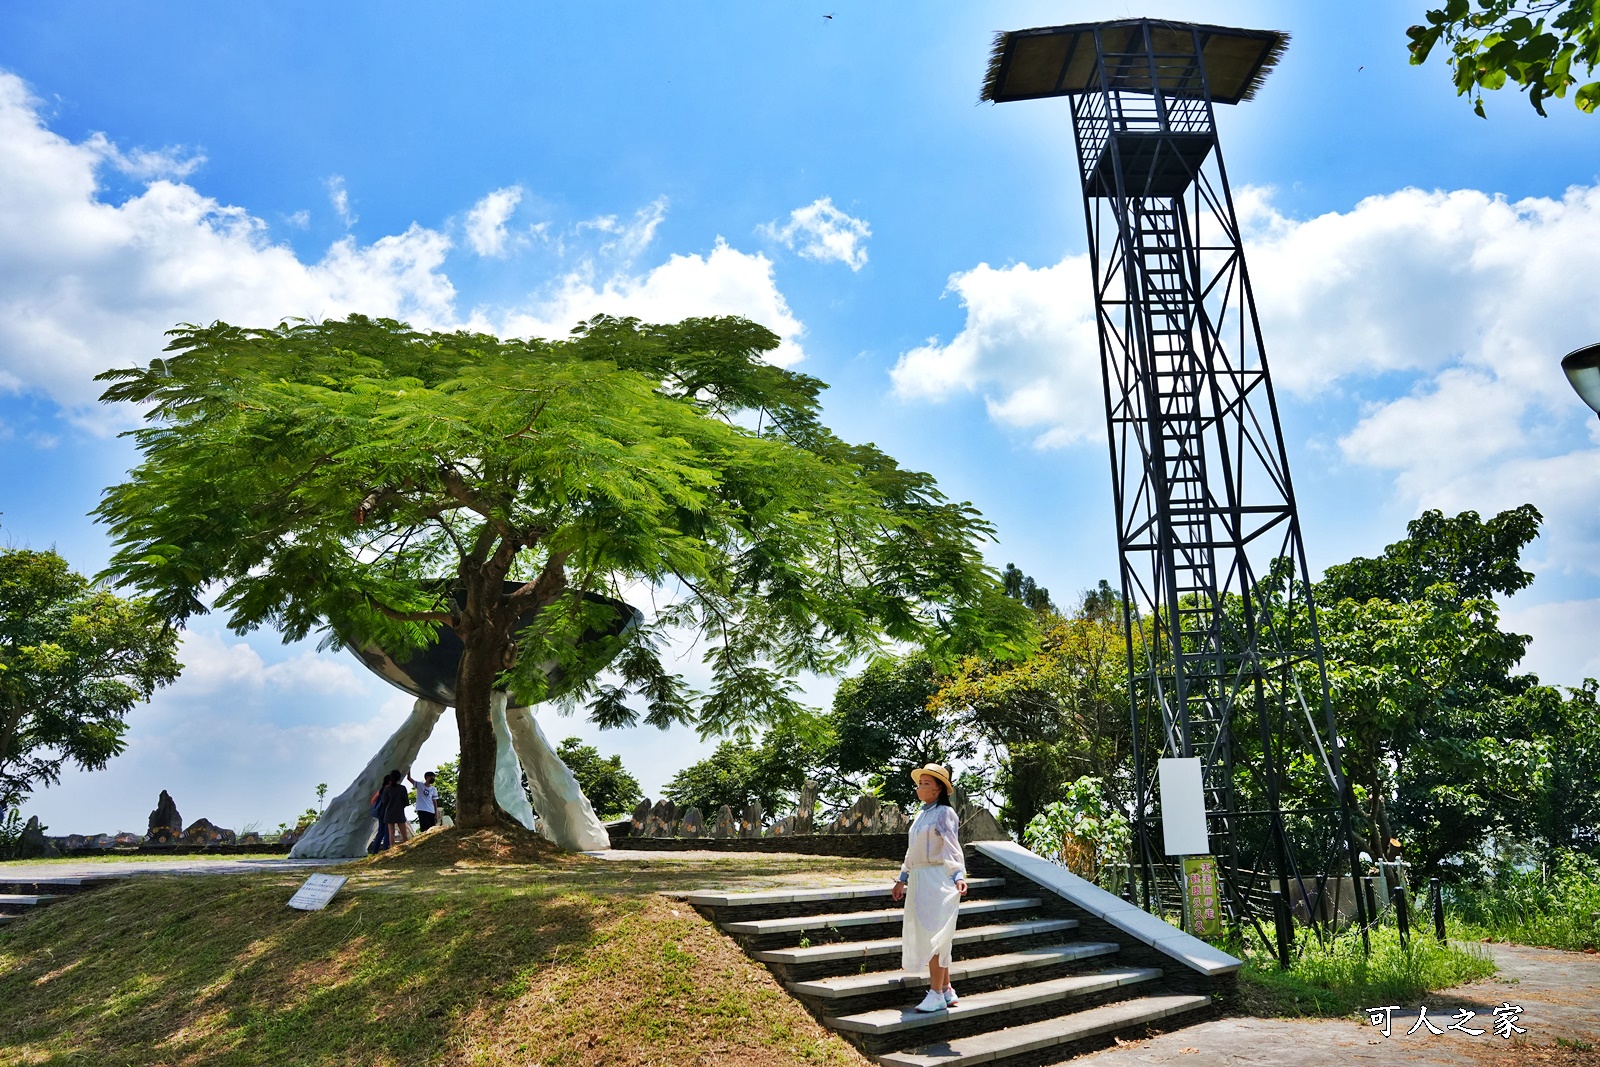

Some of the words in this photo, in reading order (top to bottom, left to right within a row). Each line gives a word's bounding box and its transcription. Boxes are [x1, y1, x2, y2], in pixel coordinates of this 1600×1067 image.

[1190, 873, 1205, 932] 健康久久久
